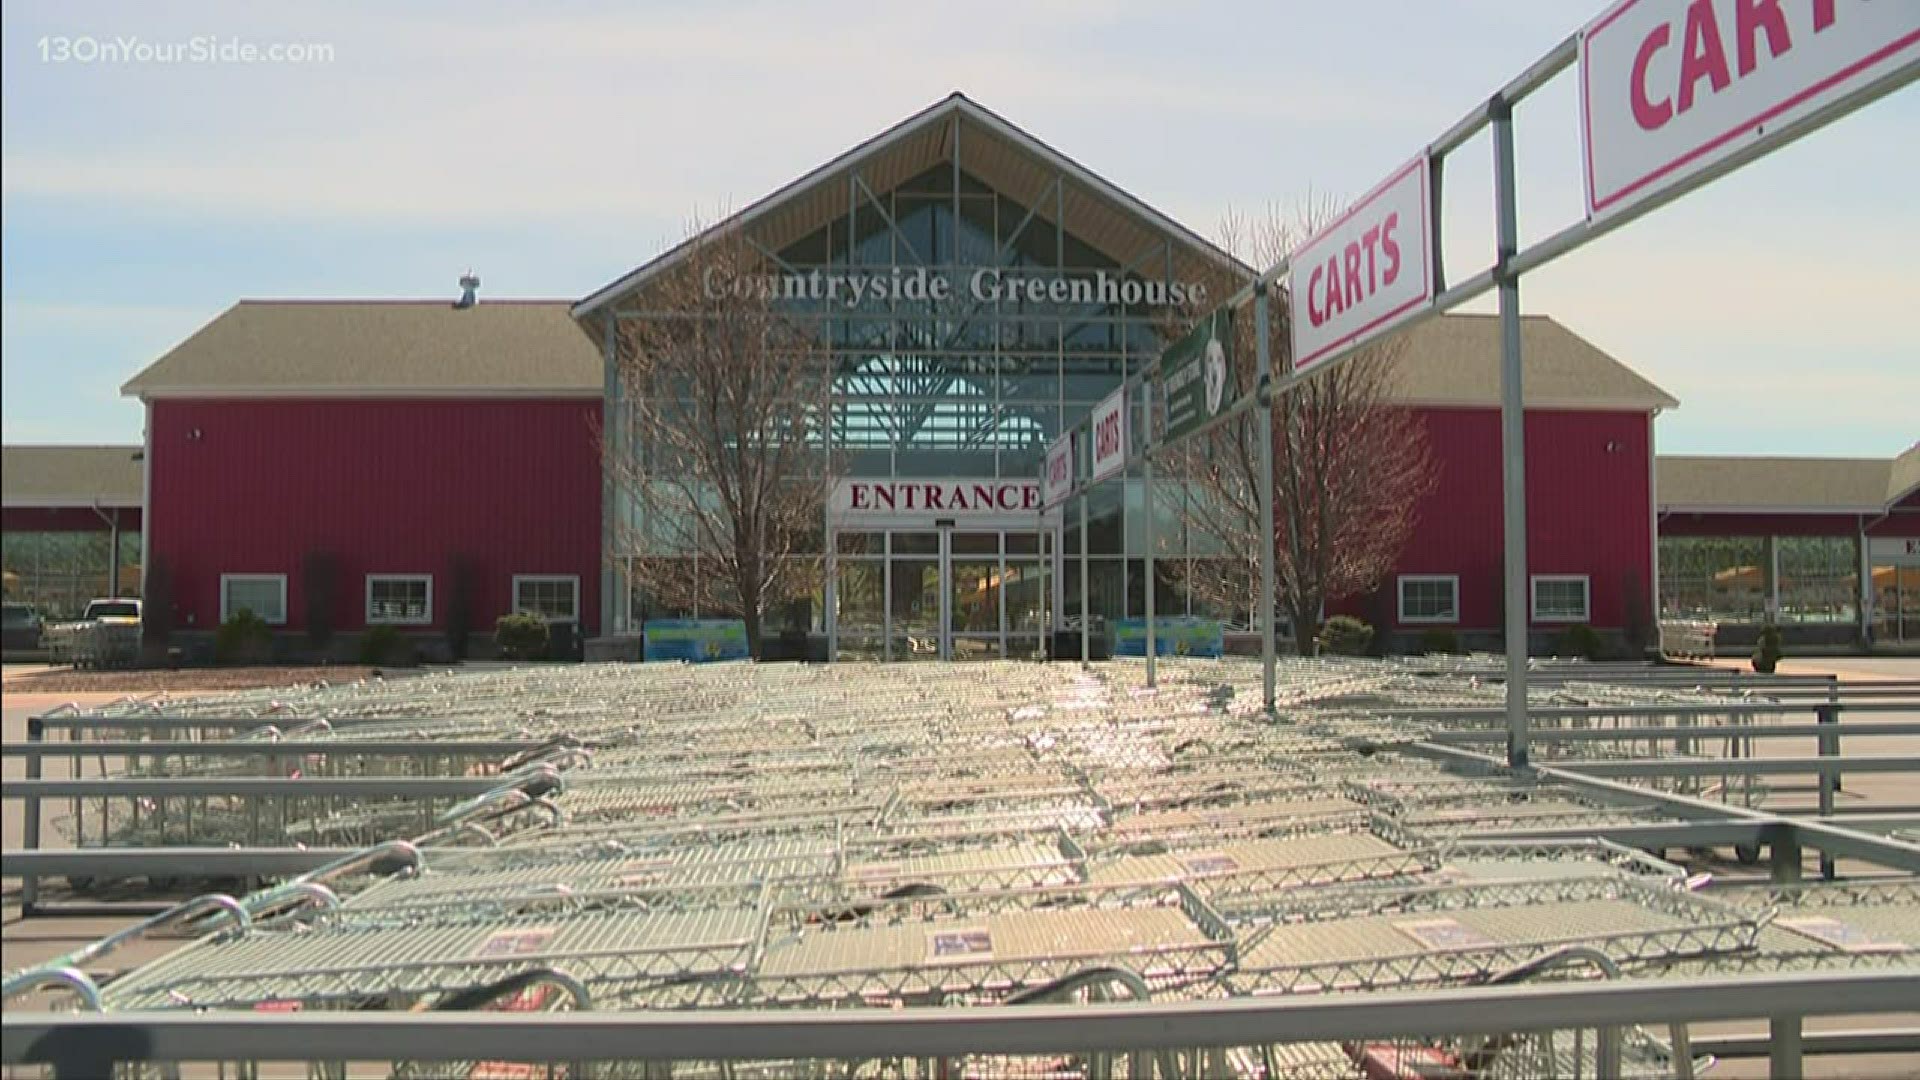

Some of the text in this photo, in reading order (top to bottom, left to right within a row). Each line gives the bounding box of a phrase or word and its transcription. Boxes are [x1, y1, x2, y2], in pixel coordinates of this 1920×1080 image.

[970, 268, 1208, 304] Greenhouse
[1308, 211, 1400, 328] CARTS
[1096, 410, 1118, 463] CARTS
[852, 484, 1039, 509] ENTRANCE
